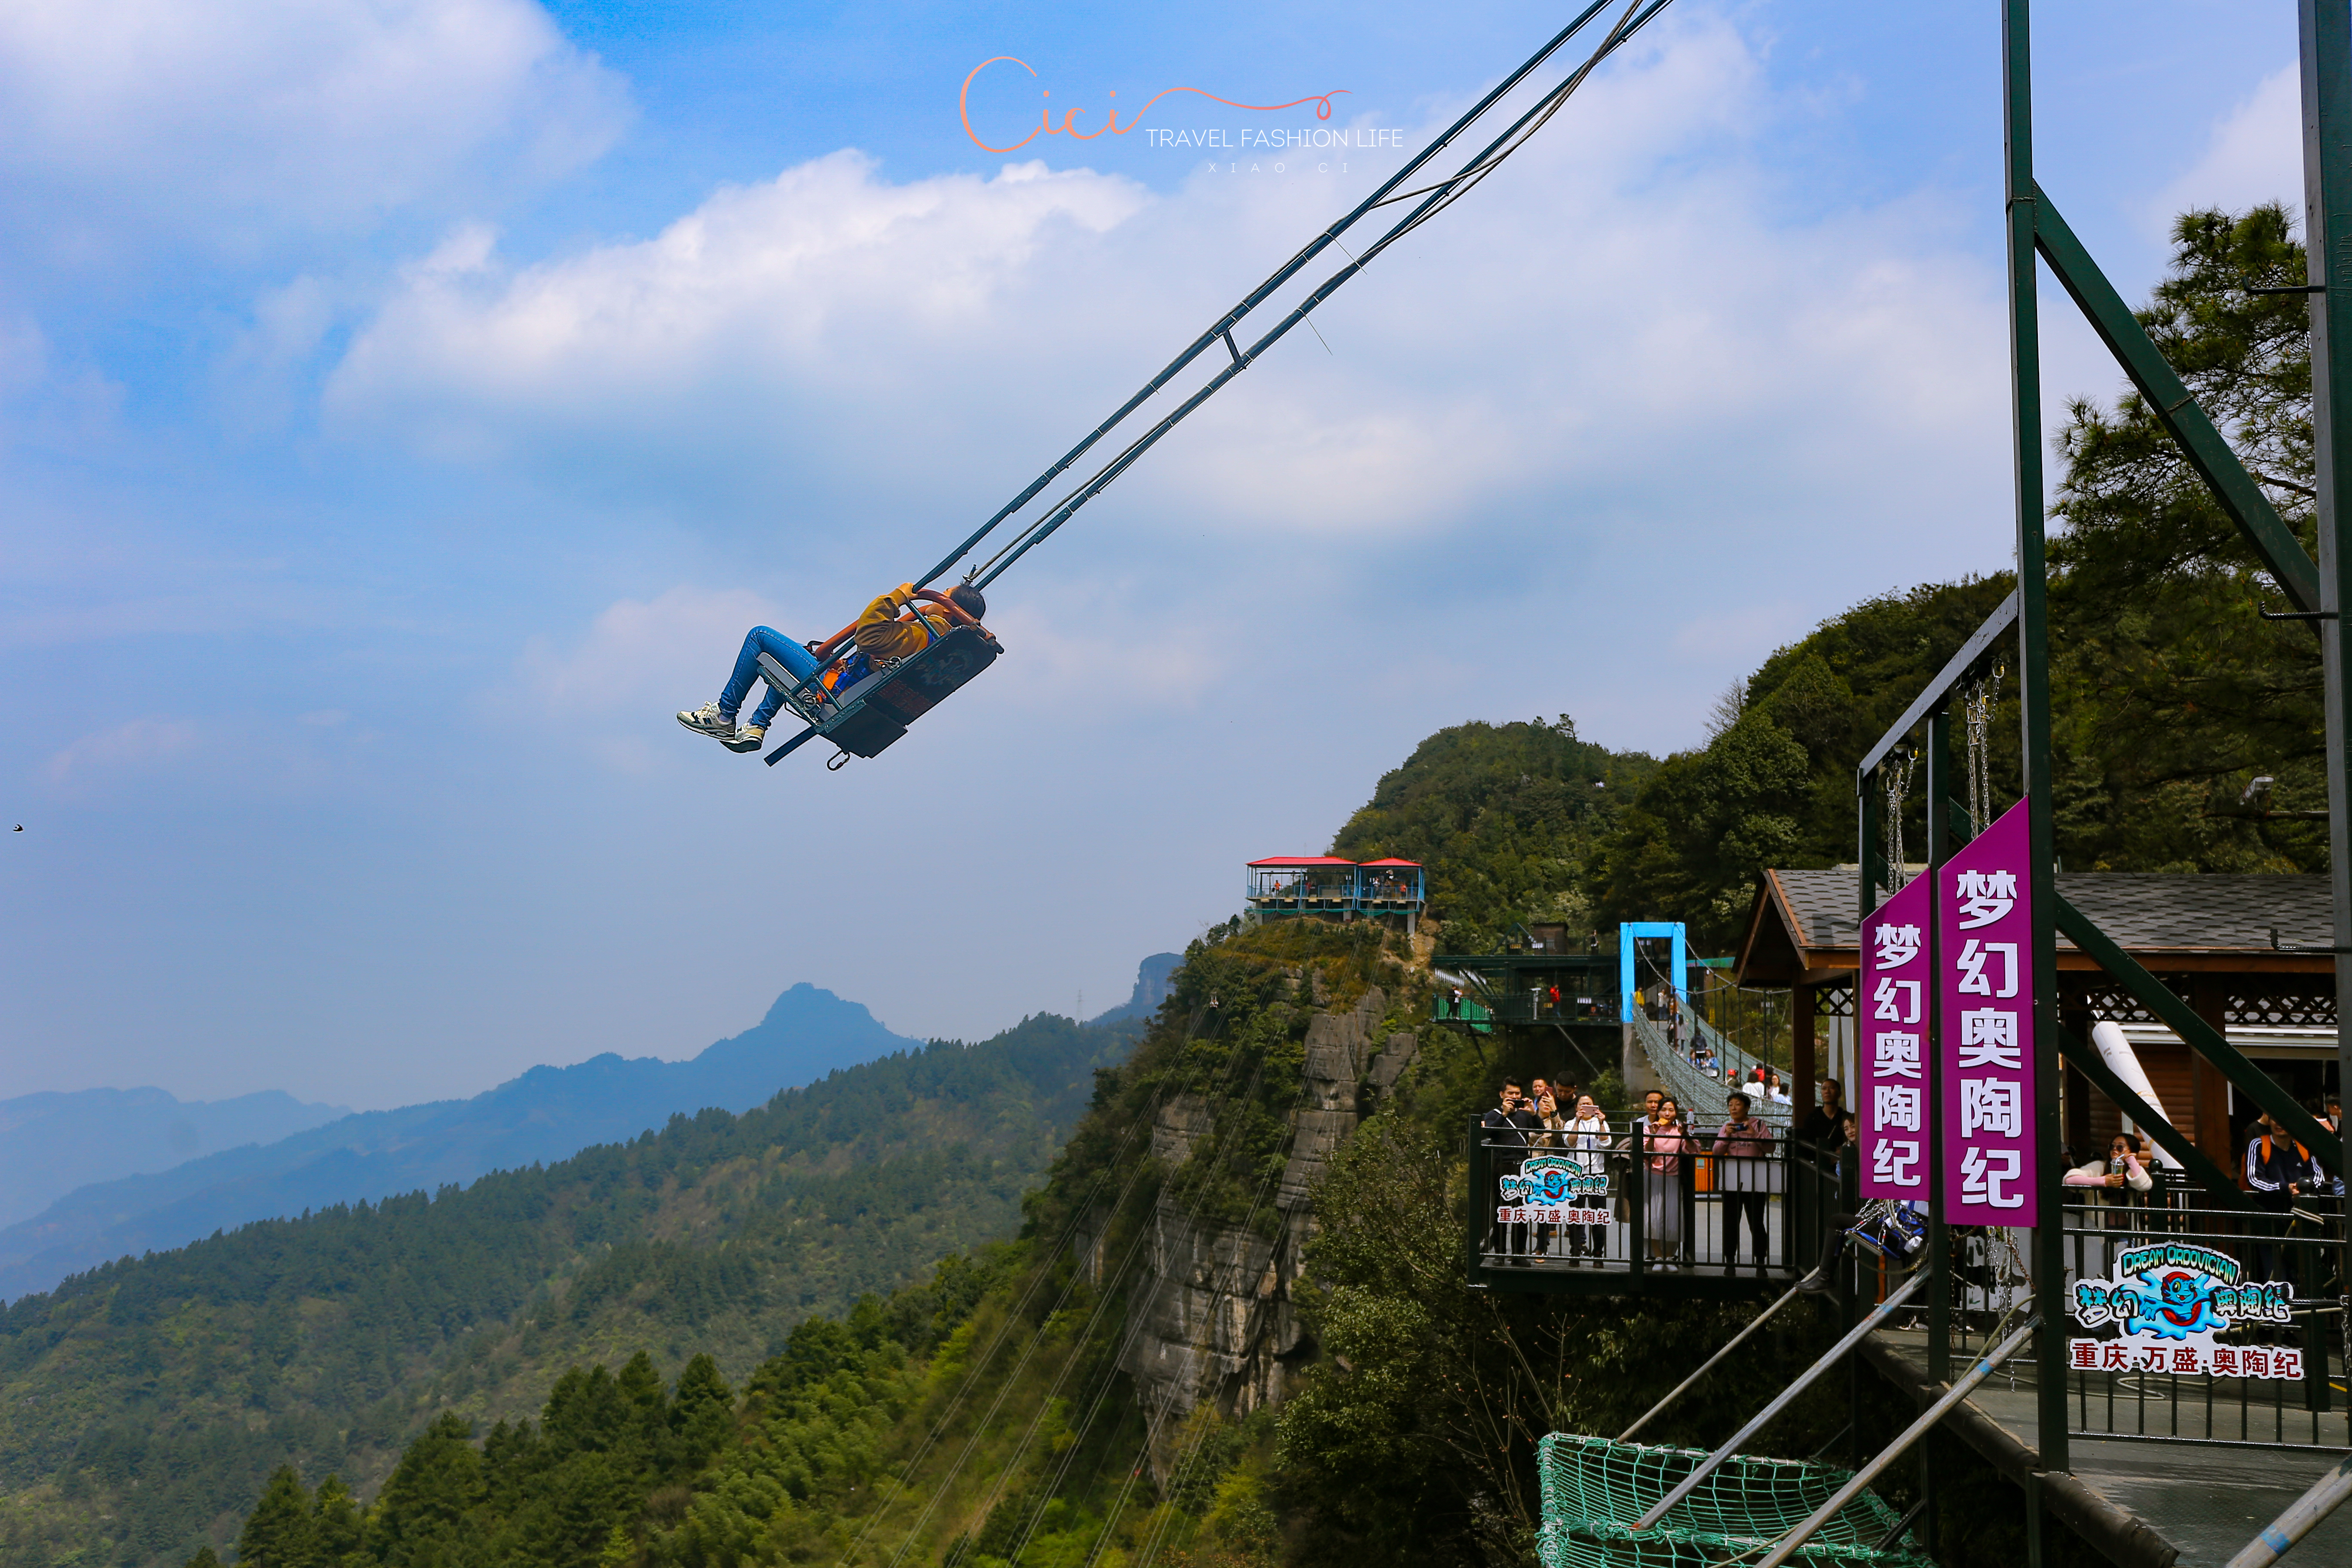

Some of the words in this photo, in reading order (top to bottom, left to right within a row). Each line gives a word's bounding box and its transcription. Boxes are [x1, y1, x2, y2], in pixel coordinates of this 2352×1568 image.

[1873, 923, 1922, 1186] 梦幻奥陶纪
[1957, 869, 2024, 1208] 梦幻奥陶纪
[1525, 1160, 1547, 1173] DREAM
[1547, 1157, 1583, 1177] ORDOVICIAN
[1503, 1179, 1533, 1199] 梦幻
[1570, 1177, 1607, 1194] 奥陶纪
[2122, 1248, 2165, 1276] DREAM
[2166, 1246, 2236, 1285] ORDOVICIAN
[2079, 1285, 2140, 1324] 梦幻
